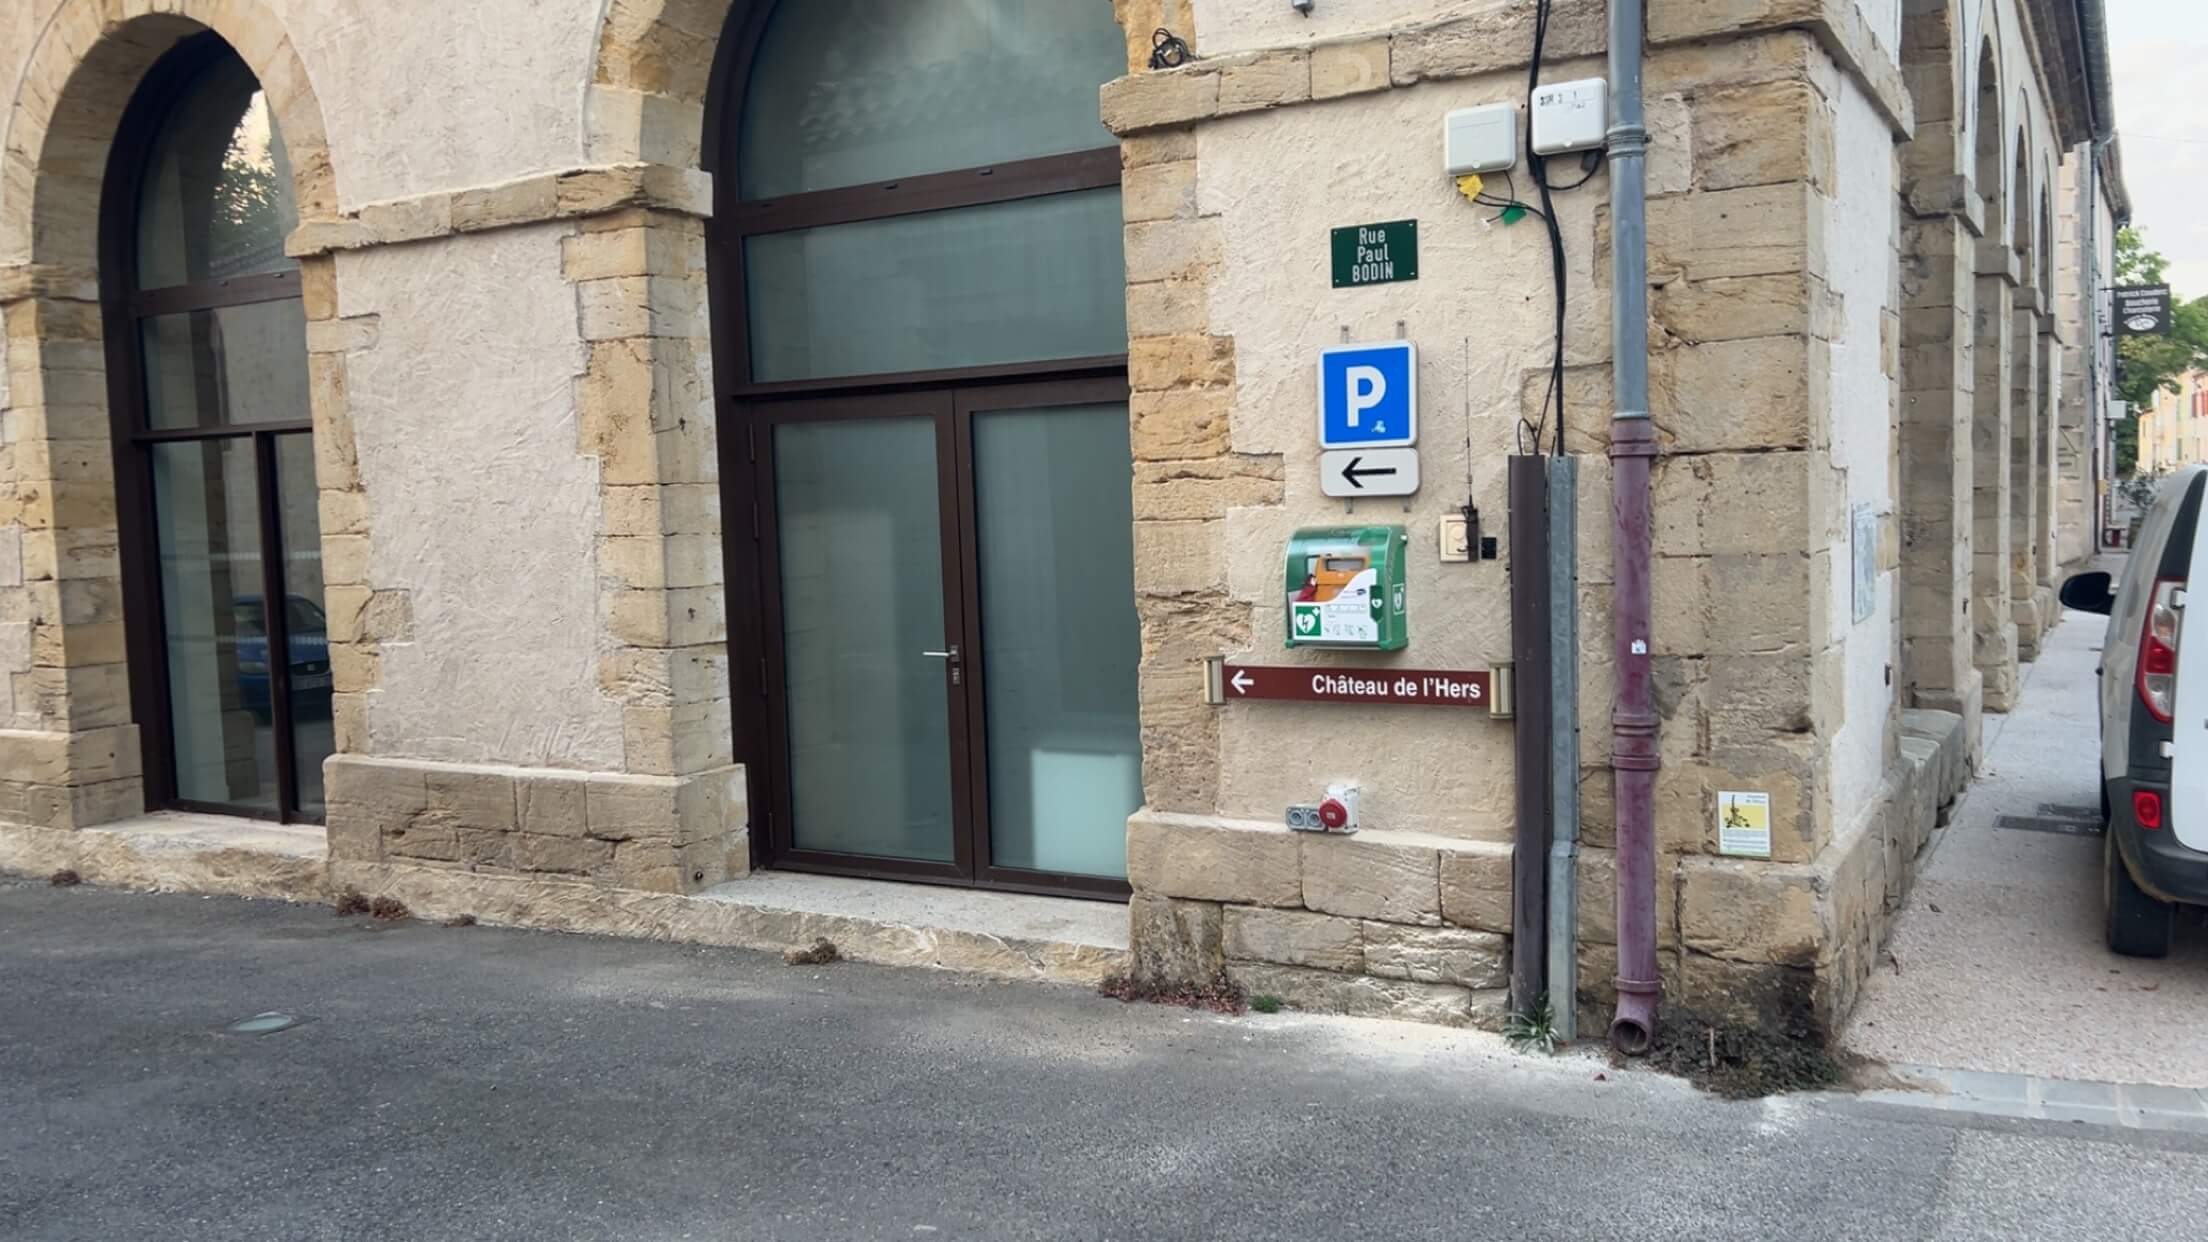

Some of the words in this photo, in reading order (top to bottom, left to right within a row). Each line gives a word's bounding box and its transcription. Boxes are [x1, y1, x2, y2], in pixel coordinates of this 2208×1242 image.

[1358, 227, 1386, 245] Rue
[1357, 243, 1389, 264] Paul
[1352, 261, 1394, 283] BODIN
[1346, 365, 1387, 428] P
[1311, 674, 1388, 696] Château
[1393, 677, 1418, 697] de
